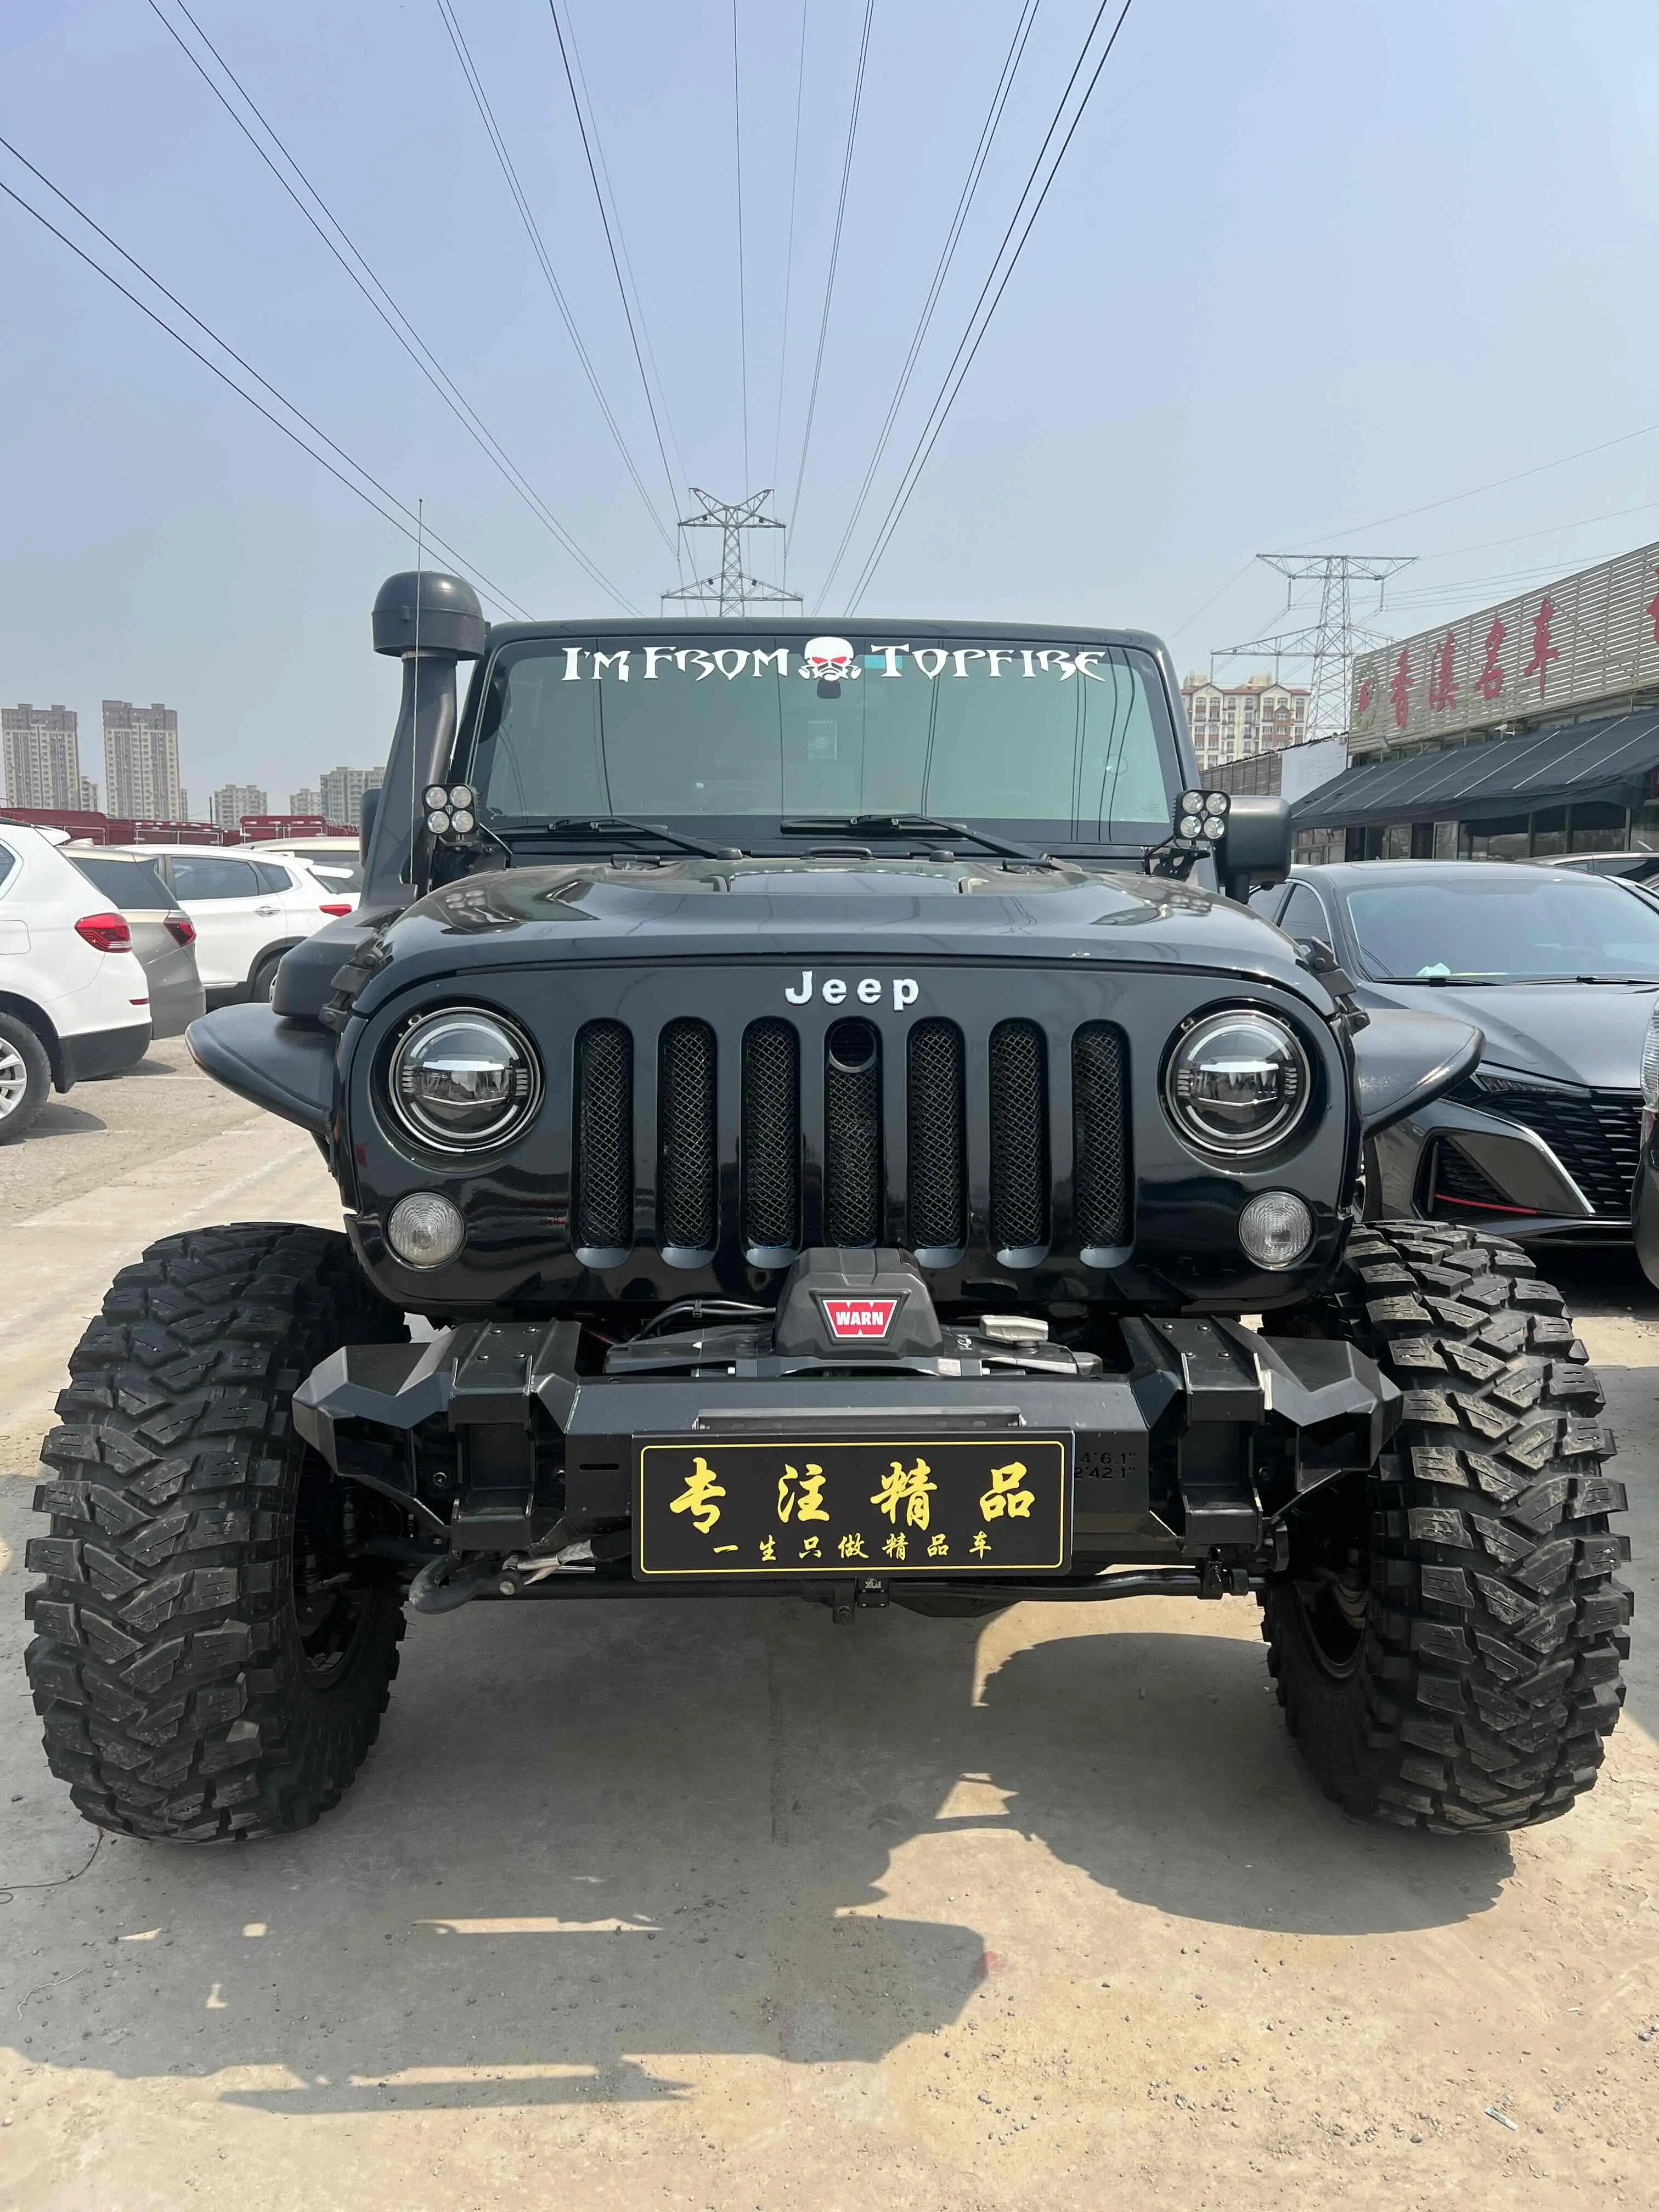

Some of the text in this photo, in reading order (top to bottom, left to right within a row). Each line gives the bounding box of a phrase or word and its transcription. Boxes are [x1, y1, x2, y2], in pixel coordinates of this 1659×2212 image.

[643, 646, 790, 682] FROM
[870, 643, 1106, 682] TOPFIRE
[785, 970, 919, 1011] Jeep
[836, 1311, 883, 1326] WARN
[669, 1457, 1035, 1534] 专注精品
[713, 1531, 992, 1562] 一生只做精品车
